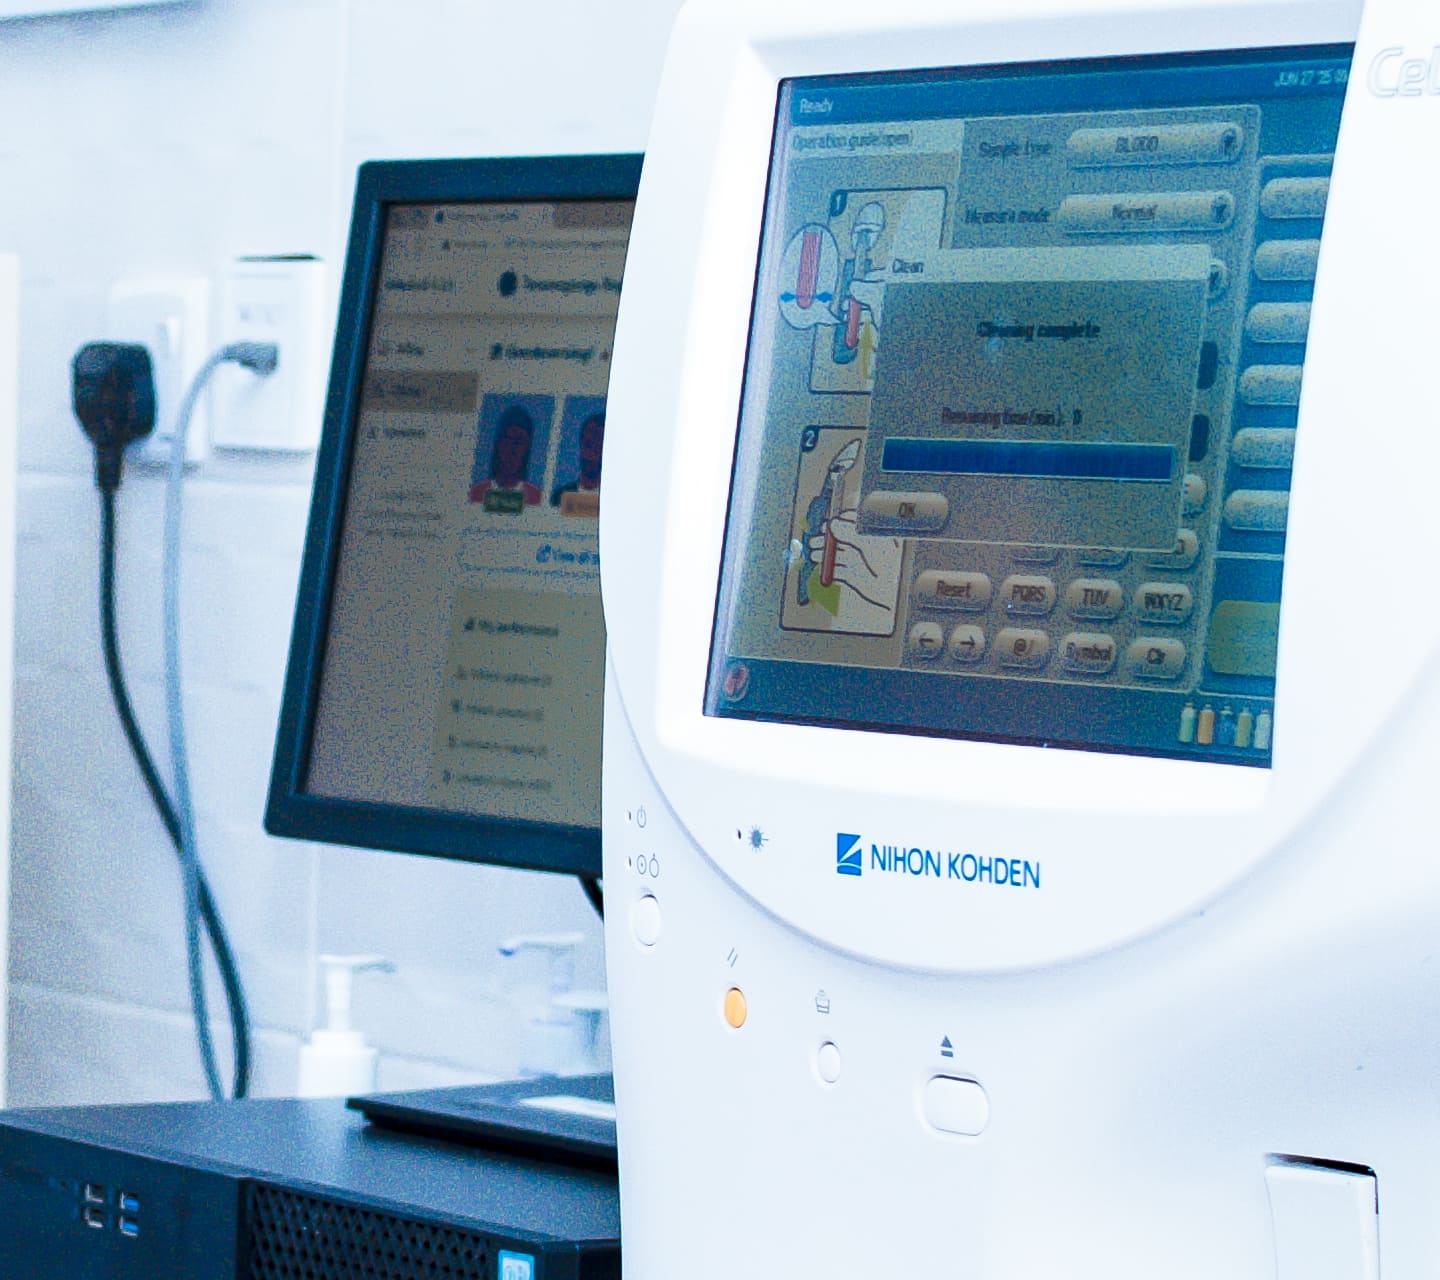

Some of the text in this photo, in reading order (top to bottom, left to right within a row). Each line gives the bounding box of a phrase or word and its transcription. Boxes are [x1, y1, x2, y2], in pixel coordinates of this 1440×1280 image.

[799, 98, 833, 114] Ready
[898, 501, 916, 518] OK
[936, 580, 972, 598] Reset
[871, 842, 1041, 889] NIHON KOHDEN
